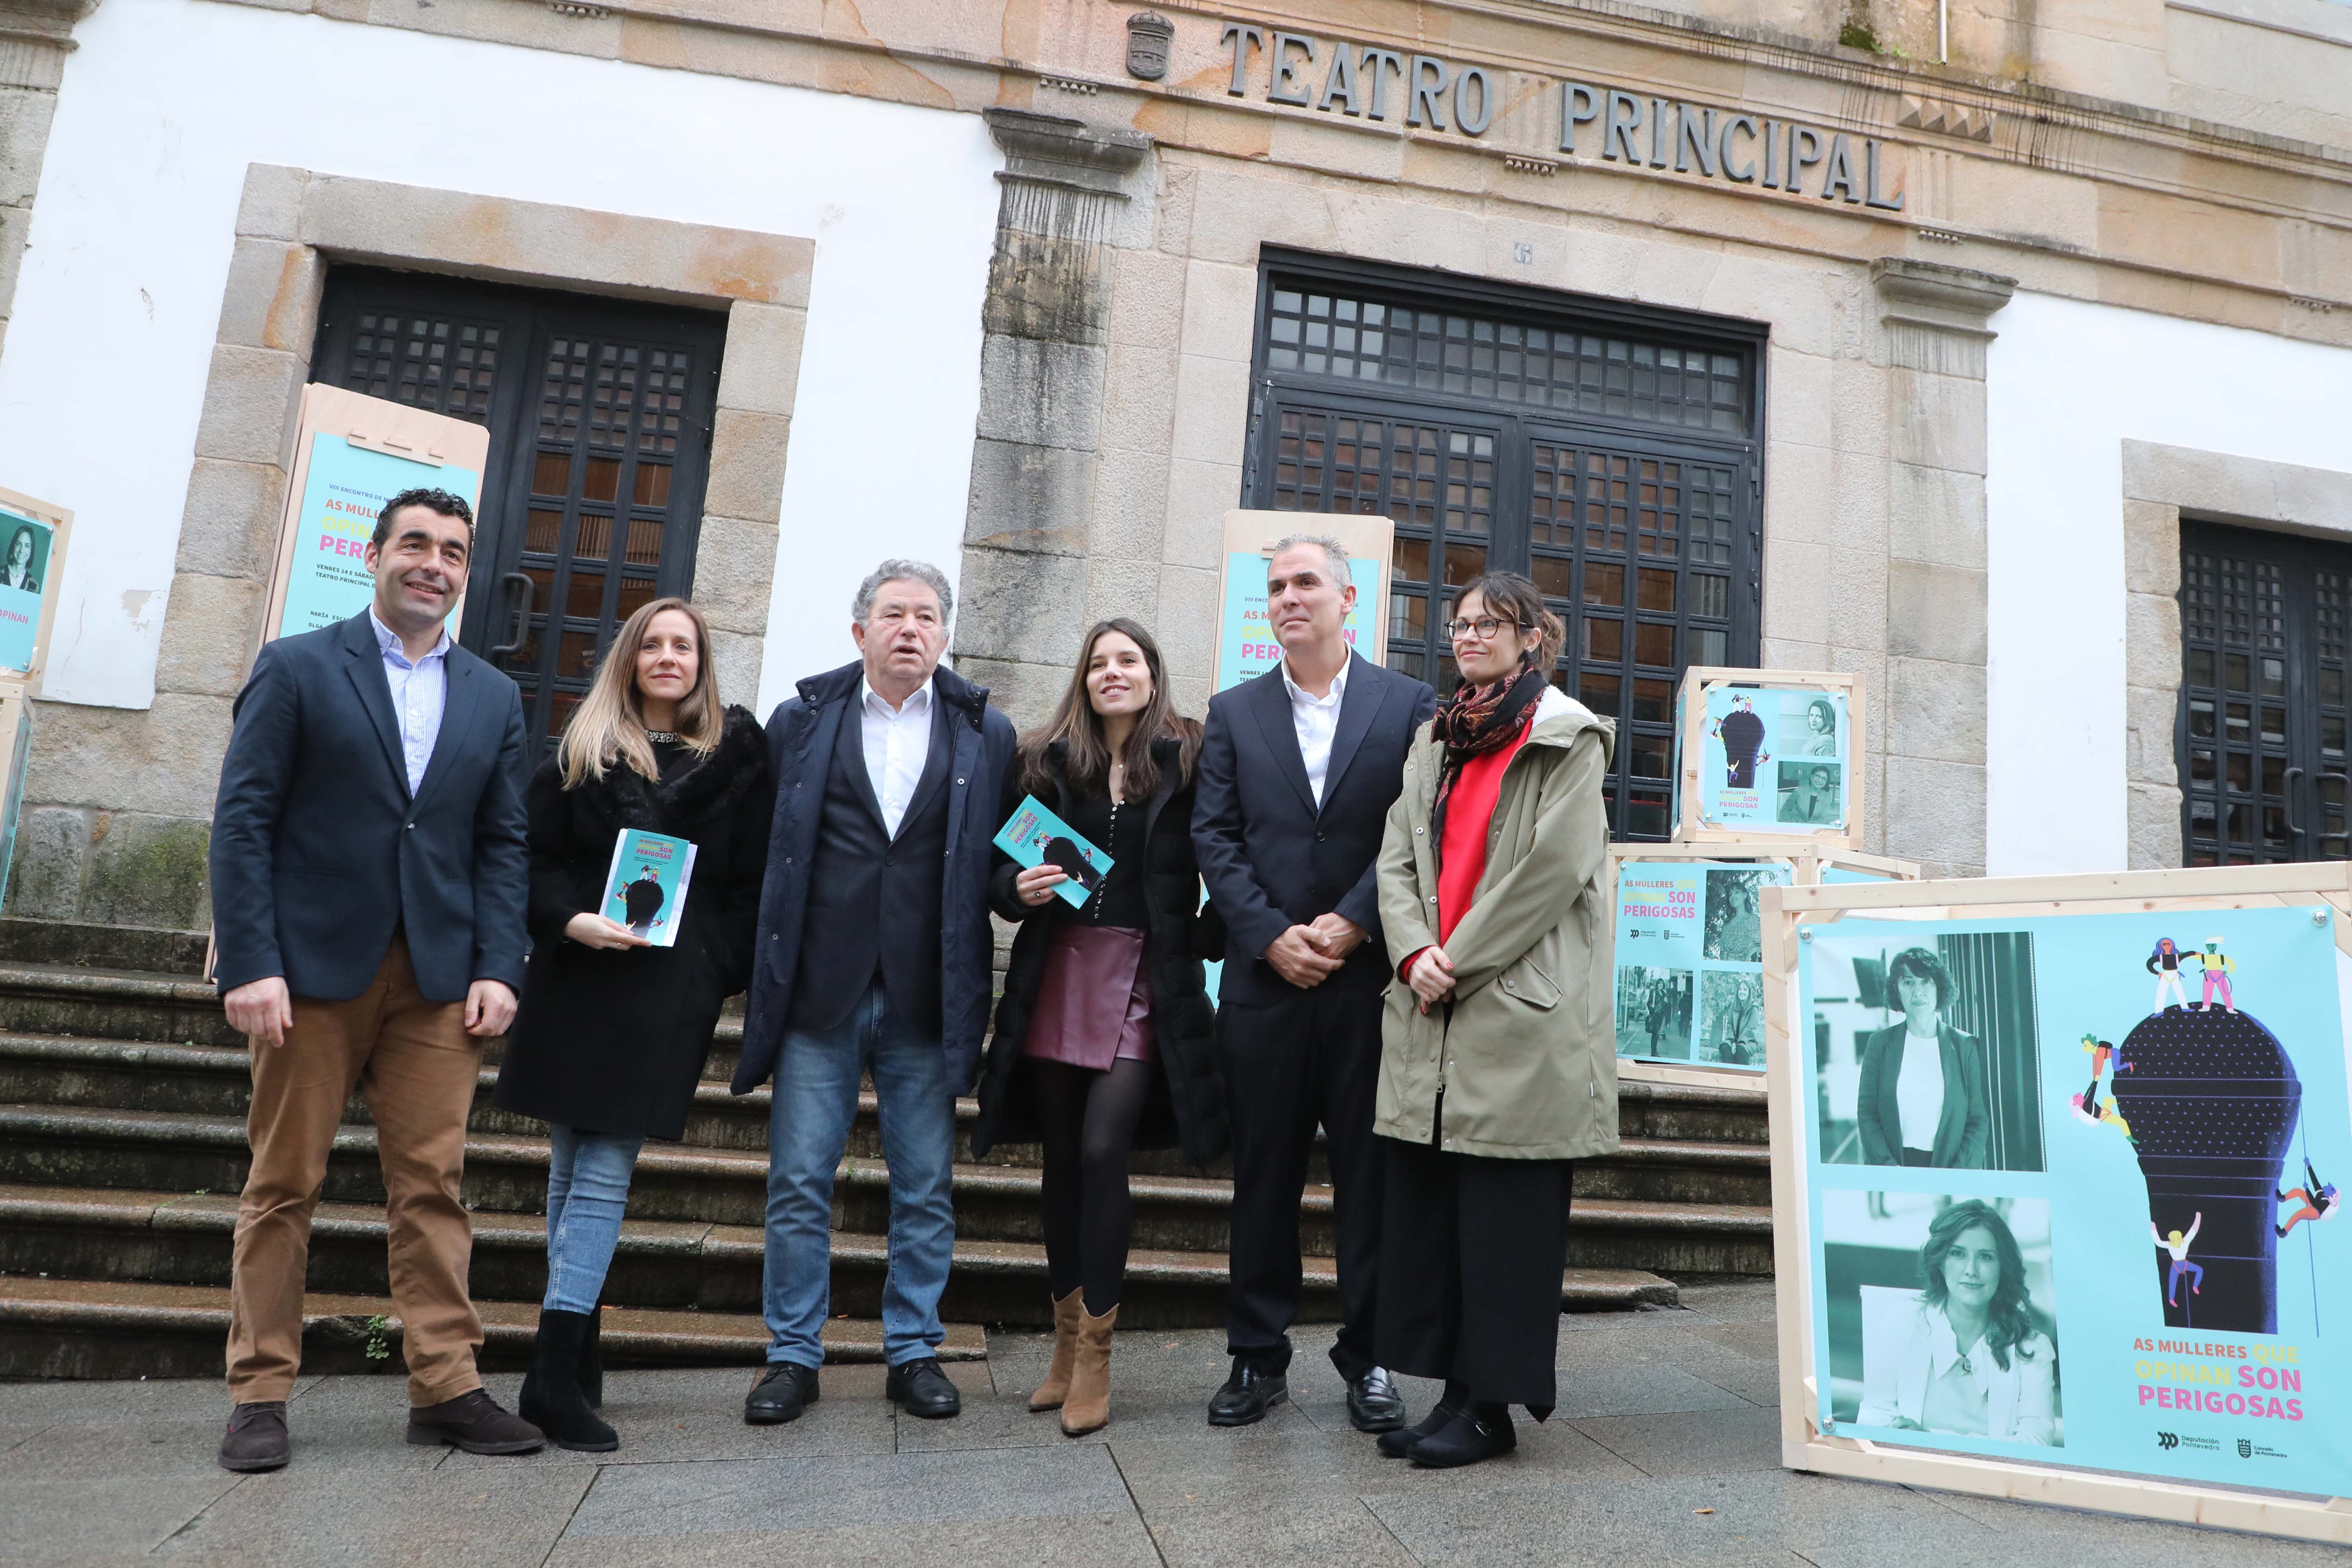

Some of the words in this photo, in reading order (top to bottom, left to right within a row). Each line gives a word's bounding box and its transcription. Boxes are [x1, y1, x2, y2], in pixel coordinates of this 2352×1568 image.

[1221, 21, 1495, 137] TEATRO
[1559, 82, 1904, 211] PRINCIPAL
[341, 487, 373, 498] ENCONTRO
[325, 499, 342, 511] AS
[346, 503, 379, 519] MULL
[322, 516, 371, 539] OPIN
[317, 564, 340, 573] VENRES
[315, 572, 339, 580] TEATRO
[340, 577, 370, 587] PRINCIPAL
[1243, 611, 1258, 620] AS
[1242, 625, 1276, 640] OPI
[1023, 812, 1033, 824] SON
[1015, 816, 1037, 844] PERIGOSAS
[636, 849, 671, 860] PERIGOSAS
[1677, 879, 1696, 891] QUE
[1624, 891, 1666, 902] OPINAN
[1668, 891, 1696, 903] SON
[1624, 905, 1695, 919] PERIGOSAS
[2134, 1338, 2154, 1351] AS
[2158, 1340, 2247, 1359] MULLERES
[2253, 1343, 2300, 1365] QUE
[2134, 1360, 2231, 1386] OPINAN
[2238, 1365, 2302, 1392] SON
[2138, 1385, 2304, 1421] PERIGOSAS
[2181, 1436, 2219, 1445] Deputación
[2182, 1441, 2220, 1450] Pontevedra
